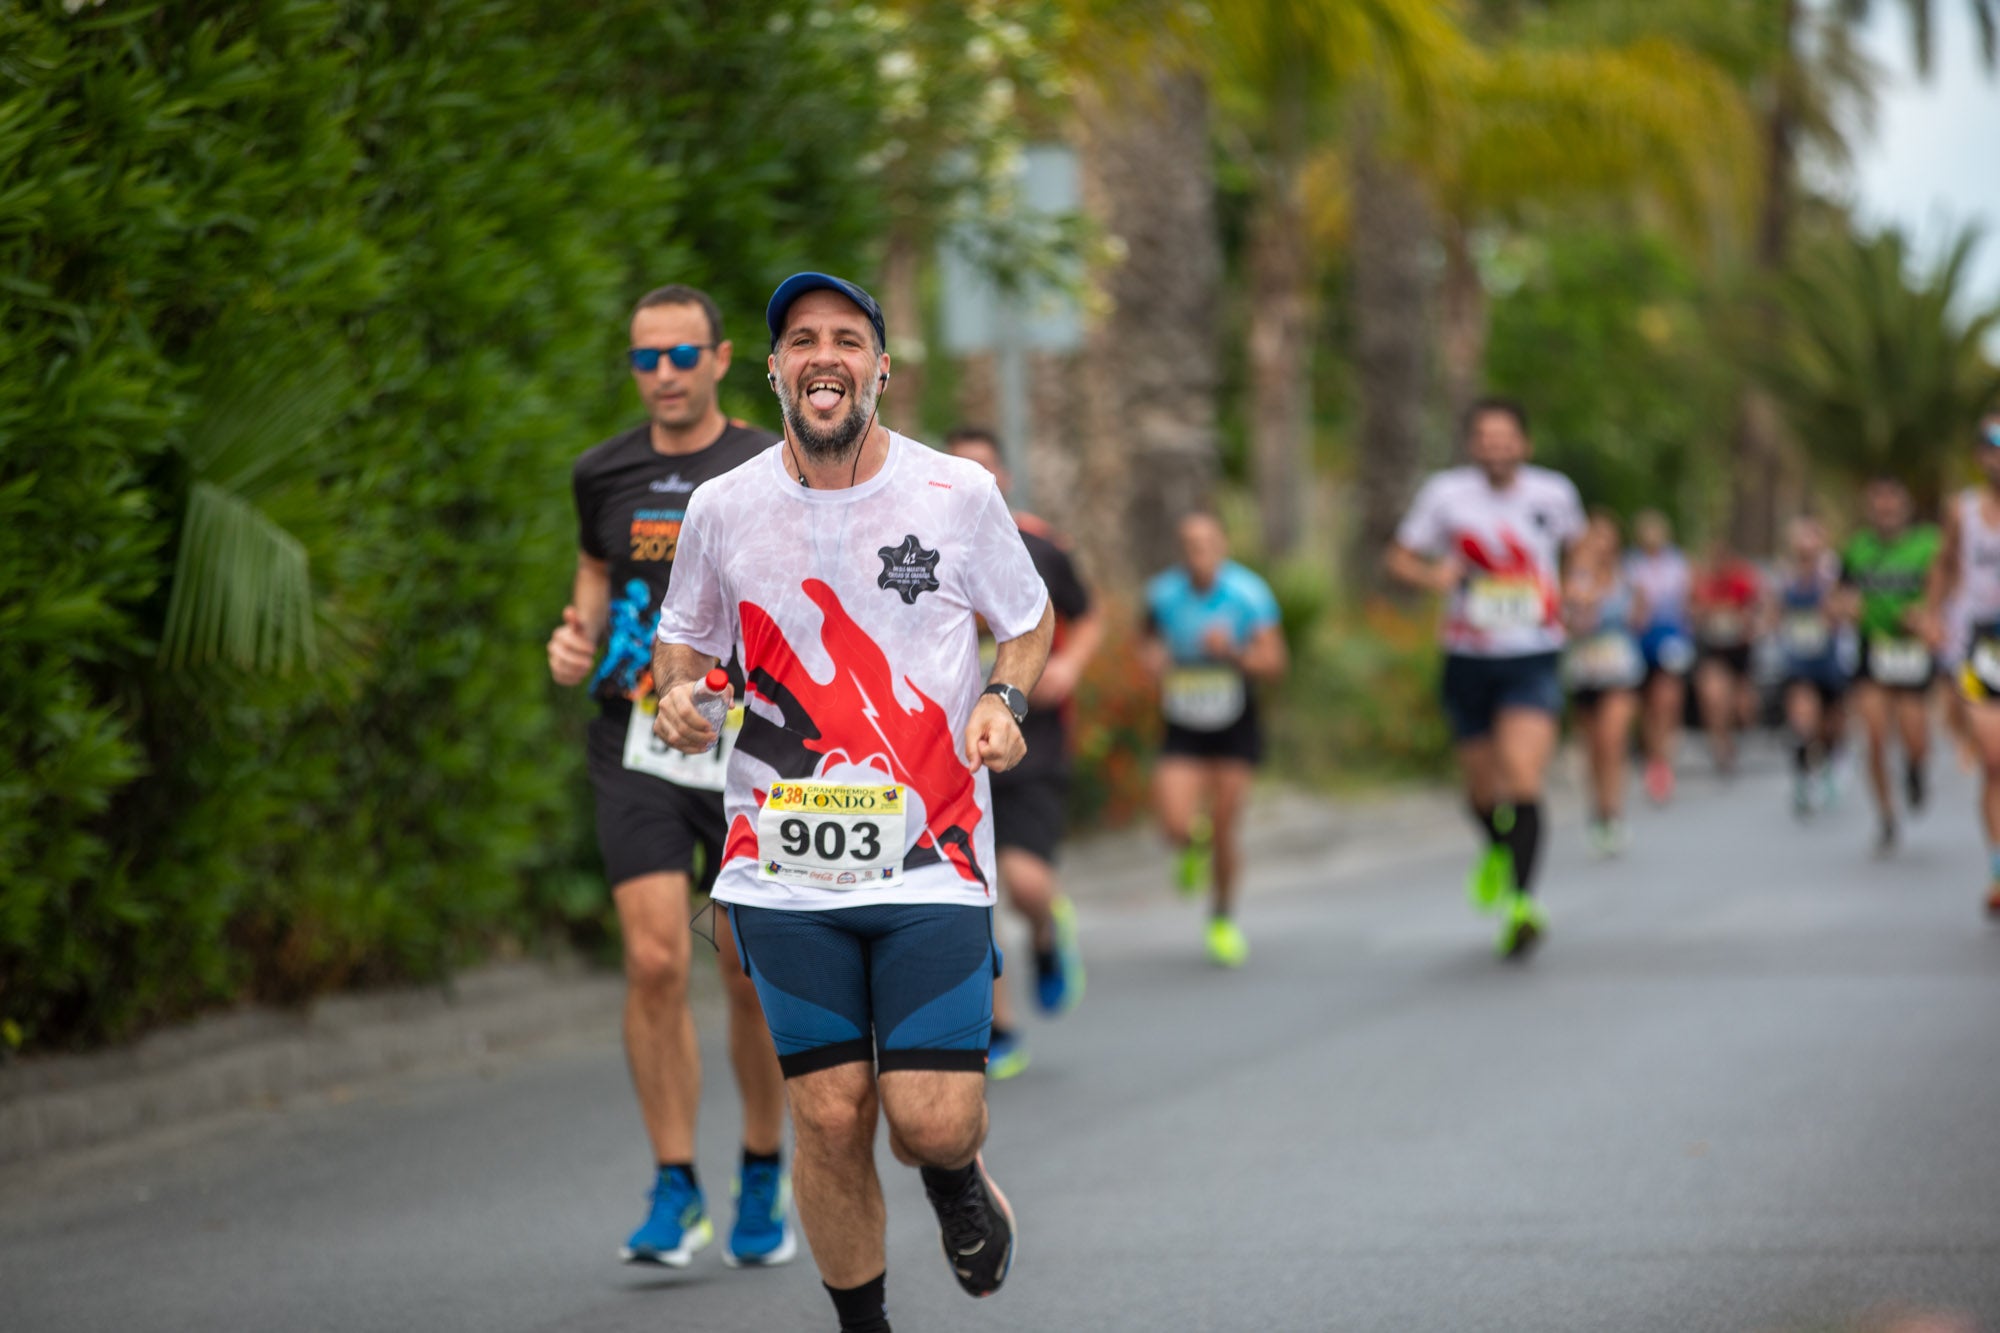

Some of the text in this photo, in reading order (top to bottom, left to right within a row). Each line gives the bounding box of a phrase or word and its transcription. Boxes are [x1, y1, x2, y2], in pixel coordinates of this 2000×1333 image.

[784, 786, 803, 804] 38
[807, 786, 832, 795] GRAN
[833, 786, 869, 796] PREMIO
[780, 819, 881, 860] 903
